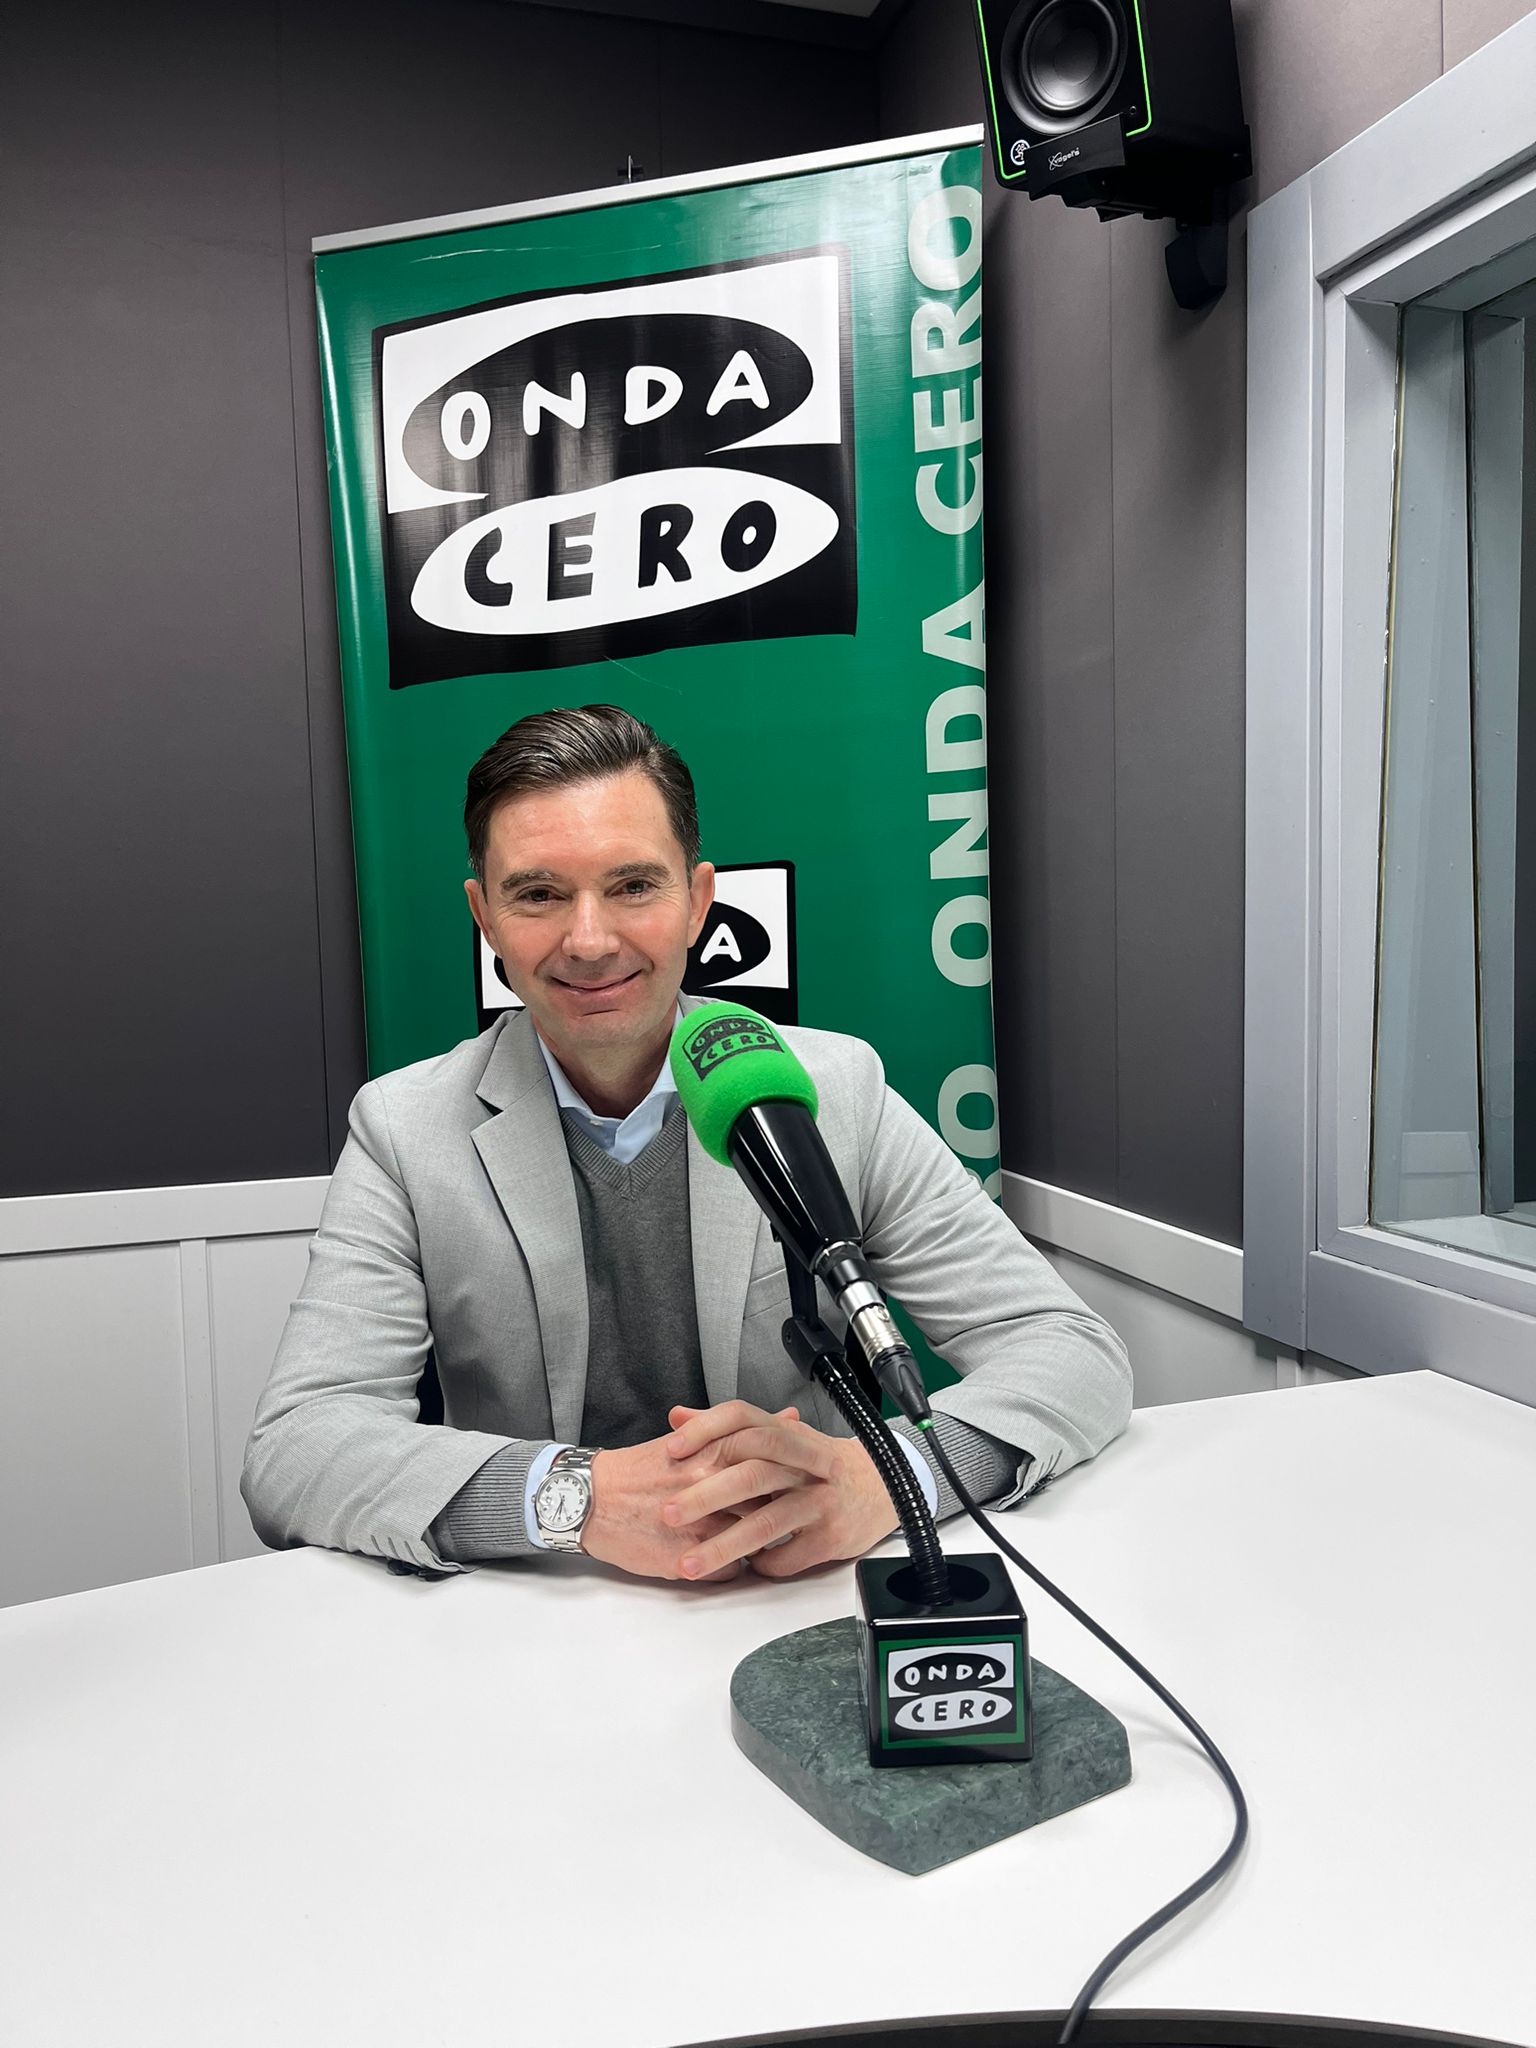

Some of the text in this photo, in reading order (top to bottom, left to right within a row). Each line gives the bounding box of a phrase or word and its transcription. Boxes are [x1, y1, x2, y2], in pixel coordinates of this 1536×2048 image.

[908, 184, 983, 536] CERO
[440, 350, 770, 461] ONDA
[463, 500, 777, 607] CERO
[922, 578, 991, 988] ONDA
[695, 1022, 759, 1047] ONDA
[707, 1034, 768, 1059] CERO
[904, 1662, 996, 1686] ONDA
[911, 1699, 997, 1723] CERO
